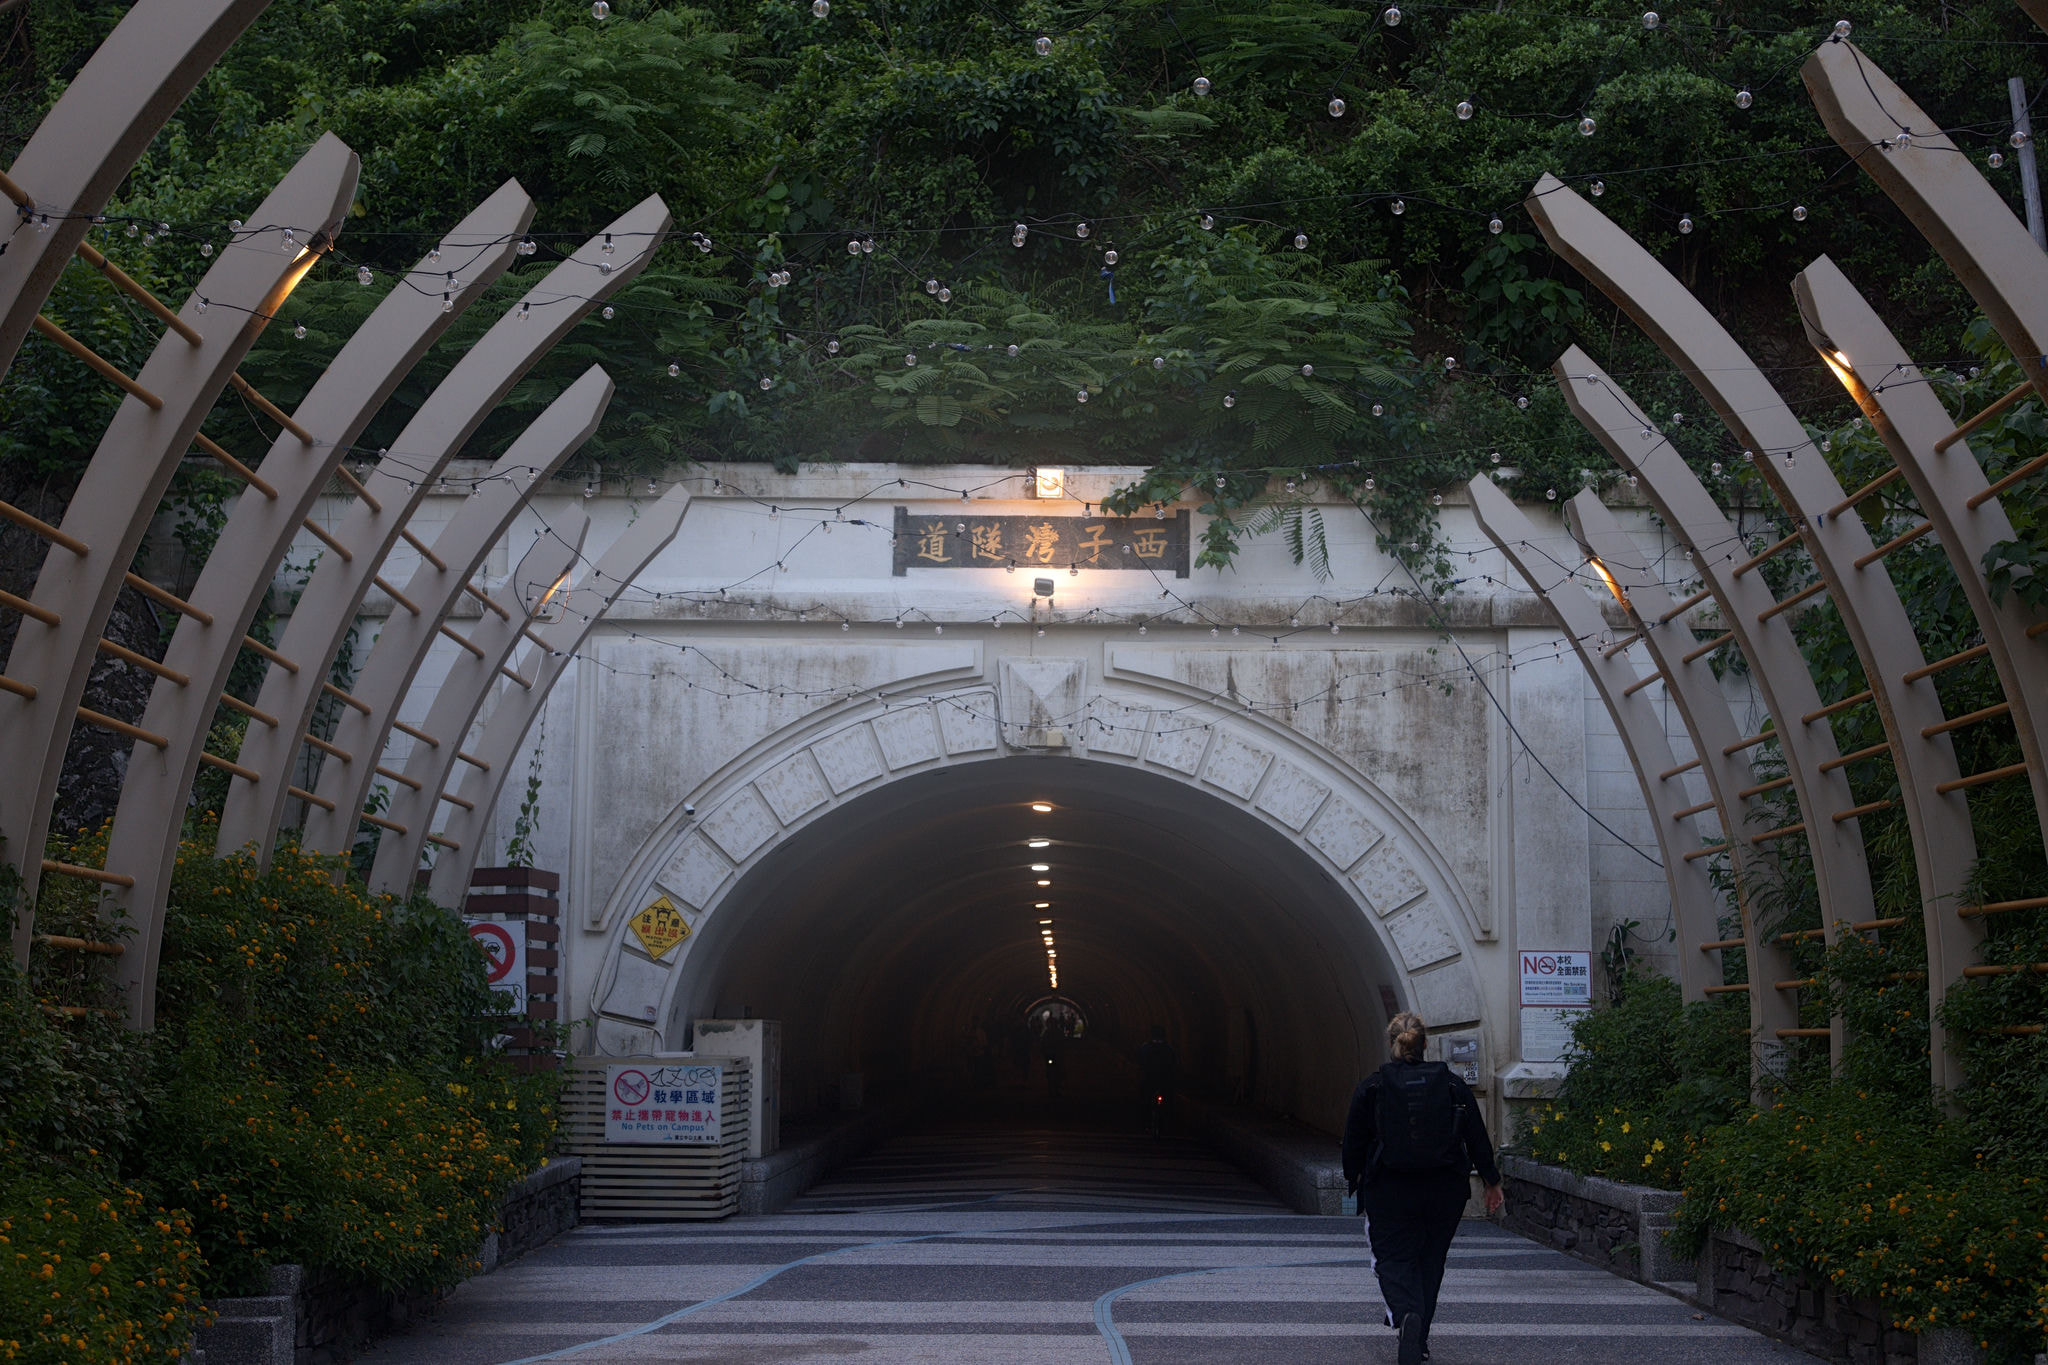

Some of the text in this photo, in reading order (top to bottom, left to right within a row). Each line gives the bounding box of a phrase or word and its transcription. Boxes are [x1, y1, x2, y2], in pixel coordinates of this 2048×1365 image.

[917, 521, 1169, 563] 西子灣隧道
[1557, 955, 1572, 965] 本校
[611, 1109, 716, 1122] 禁止攜帶寵物進入
[622, 1123, 633, 1131] No
[636, 1123, 654, 1131] Pets
[671, 1123, 704, 1133] Campus
